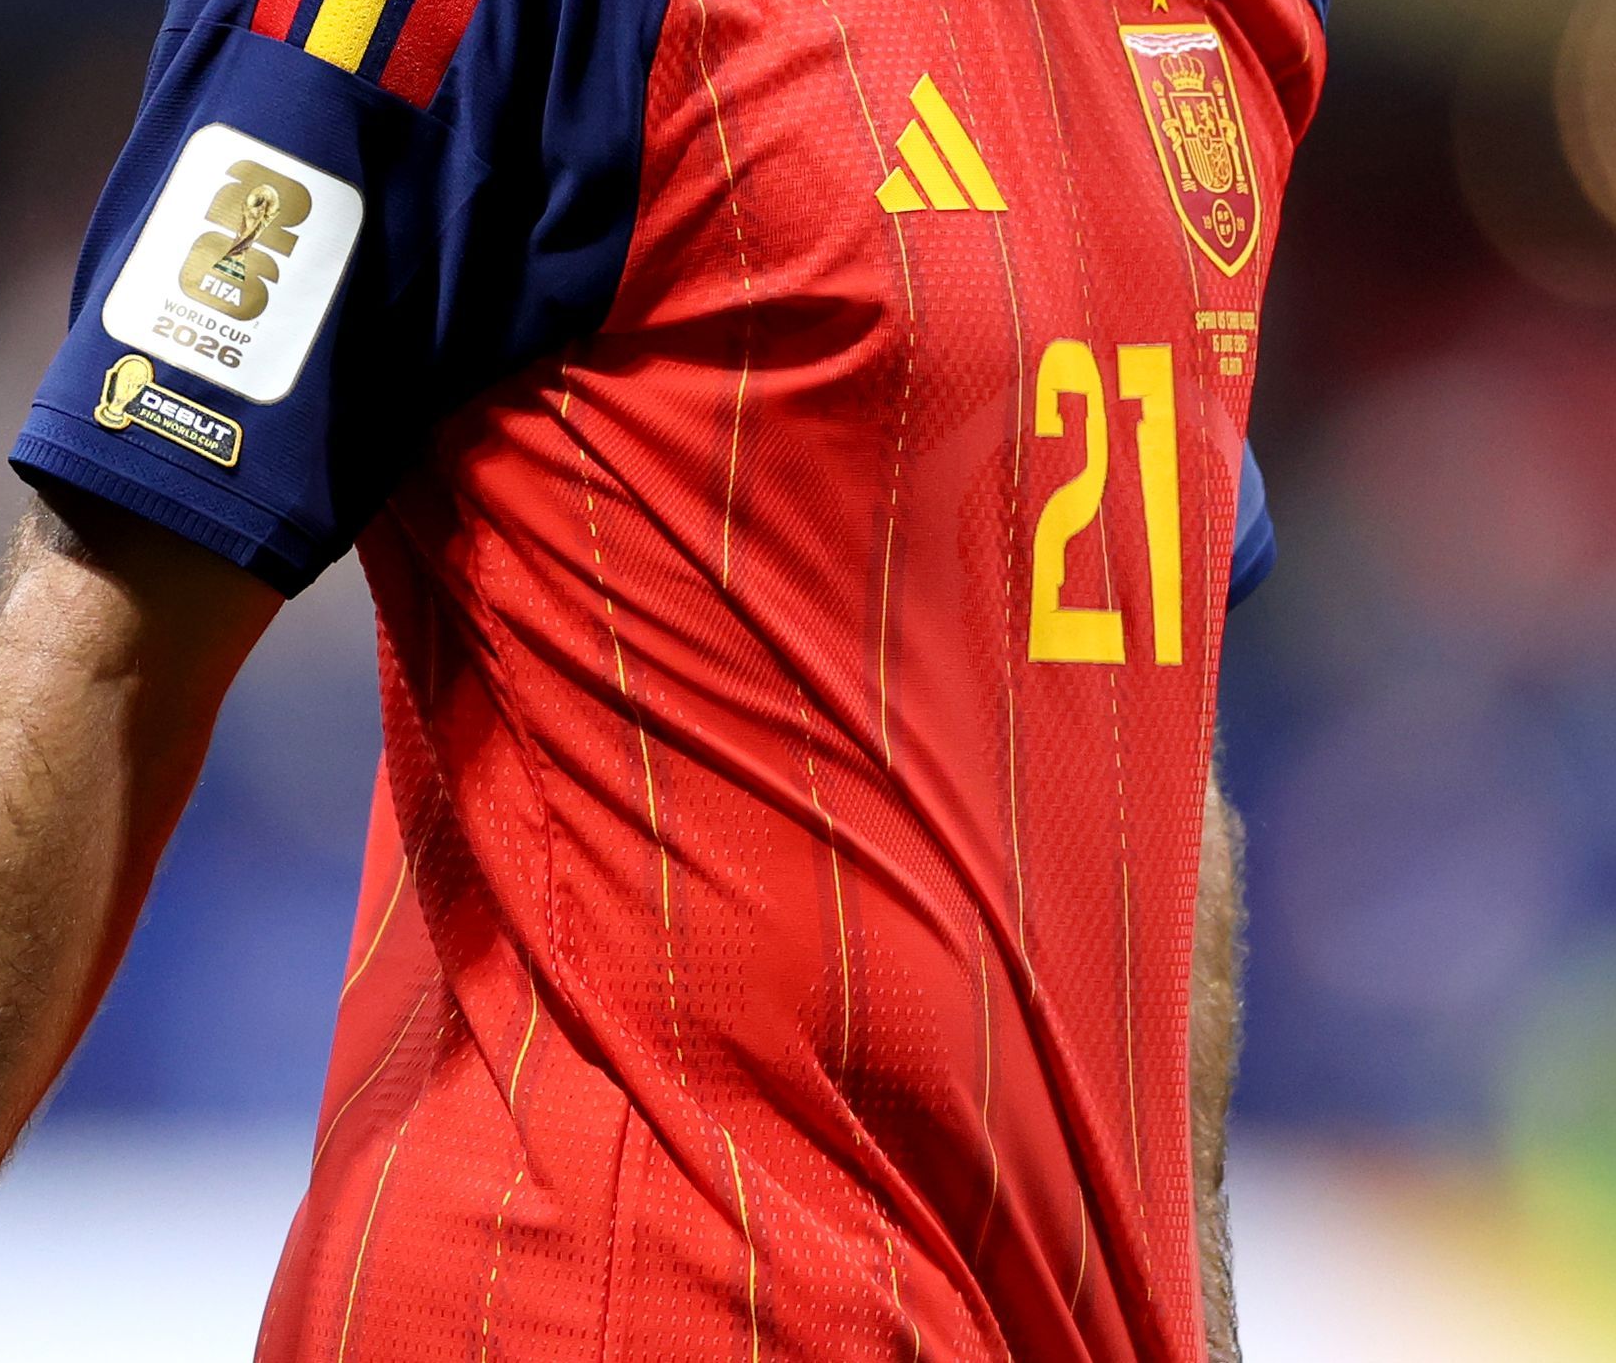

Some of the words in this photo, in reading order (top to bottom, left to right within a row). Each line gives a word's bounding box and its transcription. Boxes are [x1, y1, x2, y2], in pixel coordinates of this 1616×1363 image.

[199, 273, 242, 307] FIFA
[152, 315, 243, 369] 2026
[164, 298, 217, 331] WORLD
[219, 325, 251, 345] CUP
[139, 408, 162, 424] FIFA
[163, 417, 198, 441] WORLD
[198, 435, 219, 450] CUP
[140, 390, 232, 441] DEBUT
[1027, 337, 1183, 666] 21
